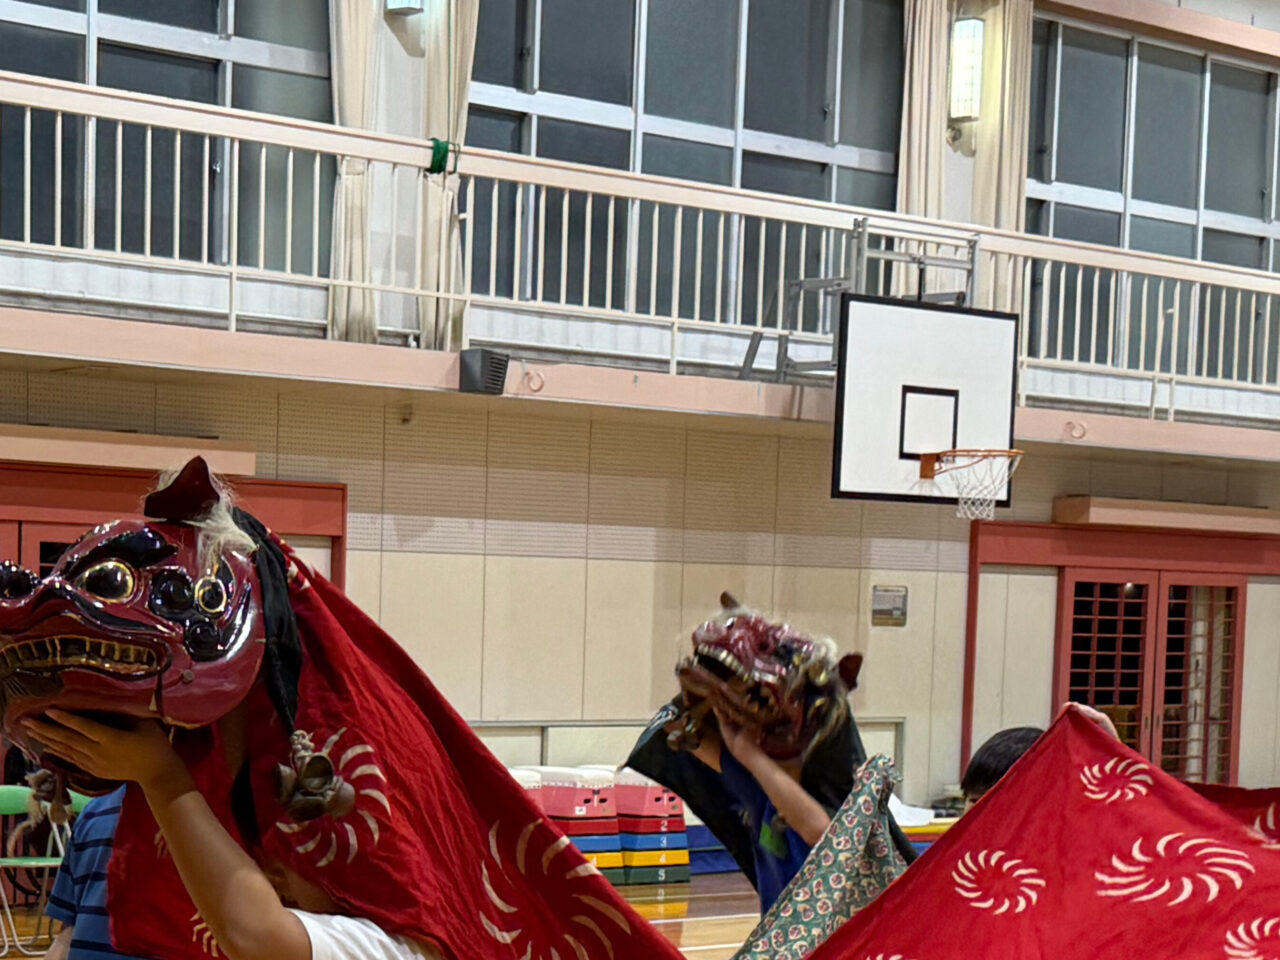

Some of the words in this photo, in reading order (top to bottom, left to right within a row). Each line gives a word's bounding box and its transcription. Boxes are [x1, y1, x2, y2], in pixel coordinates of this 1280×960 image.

[660, 820, 668, 832] 2
[659, 836, 667, 848] 3
[658, 853, 667, 864] 4
[658, 869, 666, 881] 5
